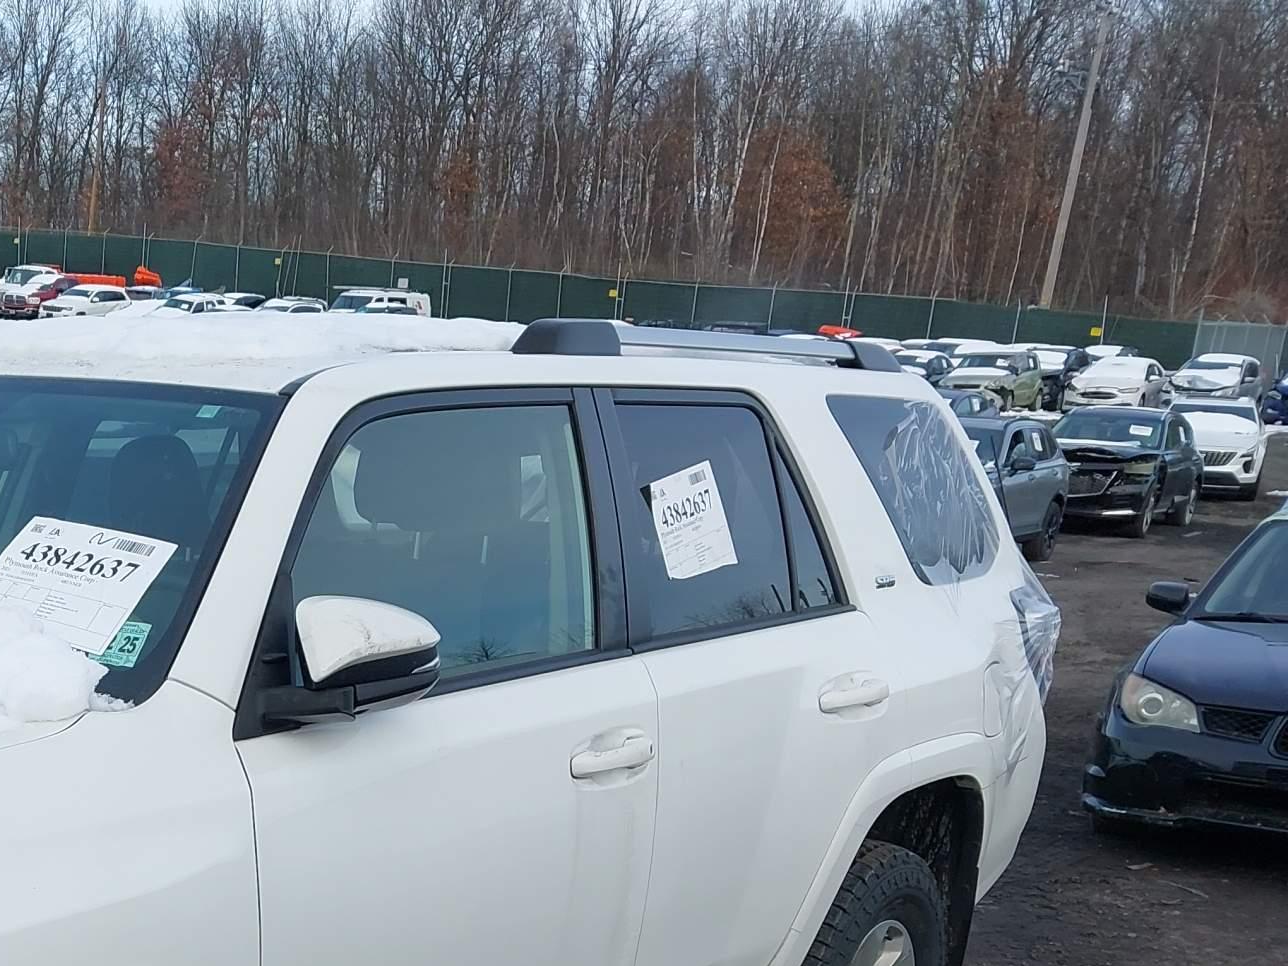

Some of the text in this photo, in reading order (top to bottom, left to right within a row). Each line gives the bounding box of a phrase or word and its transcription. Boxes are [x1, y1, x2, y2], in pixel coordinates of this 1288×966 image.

[661, 488, 713, 528] 43842637
[21, 543, 141, 582] 43842637
[118, 635, 140, 654] 25
